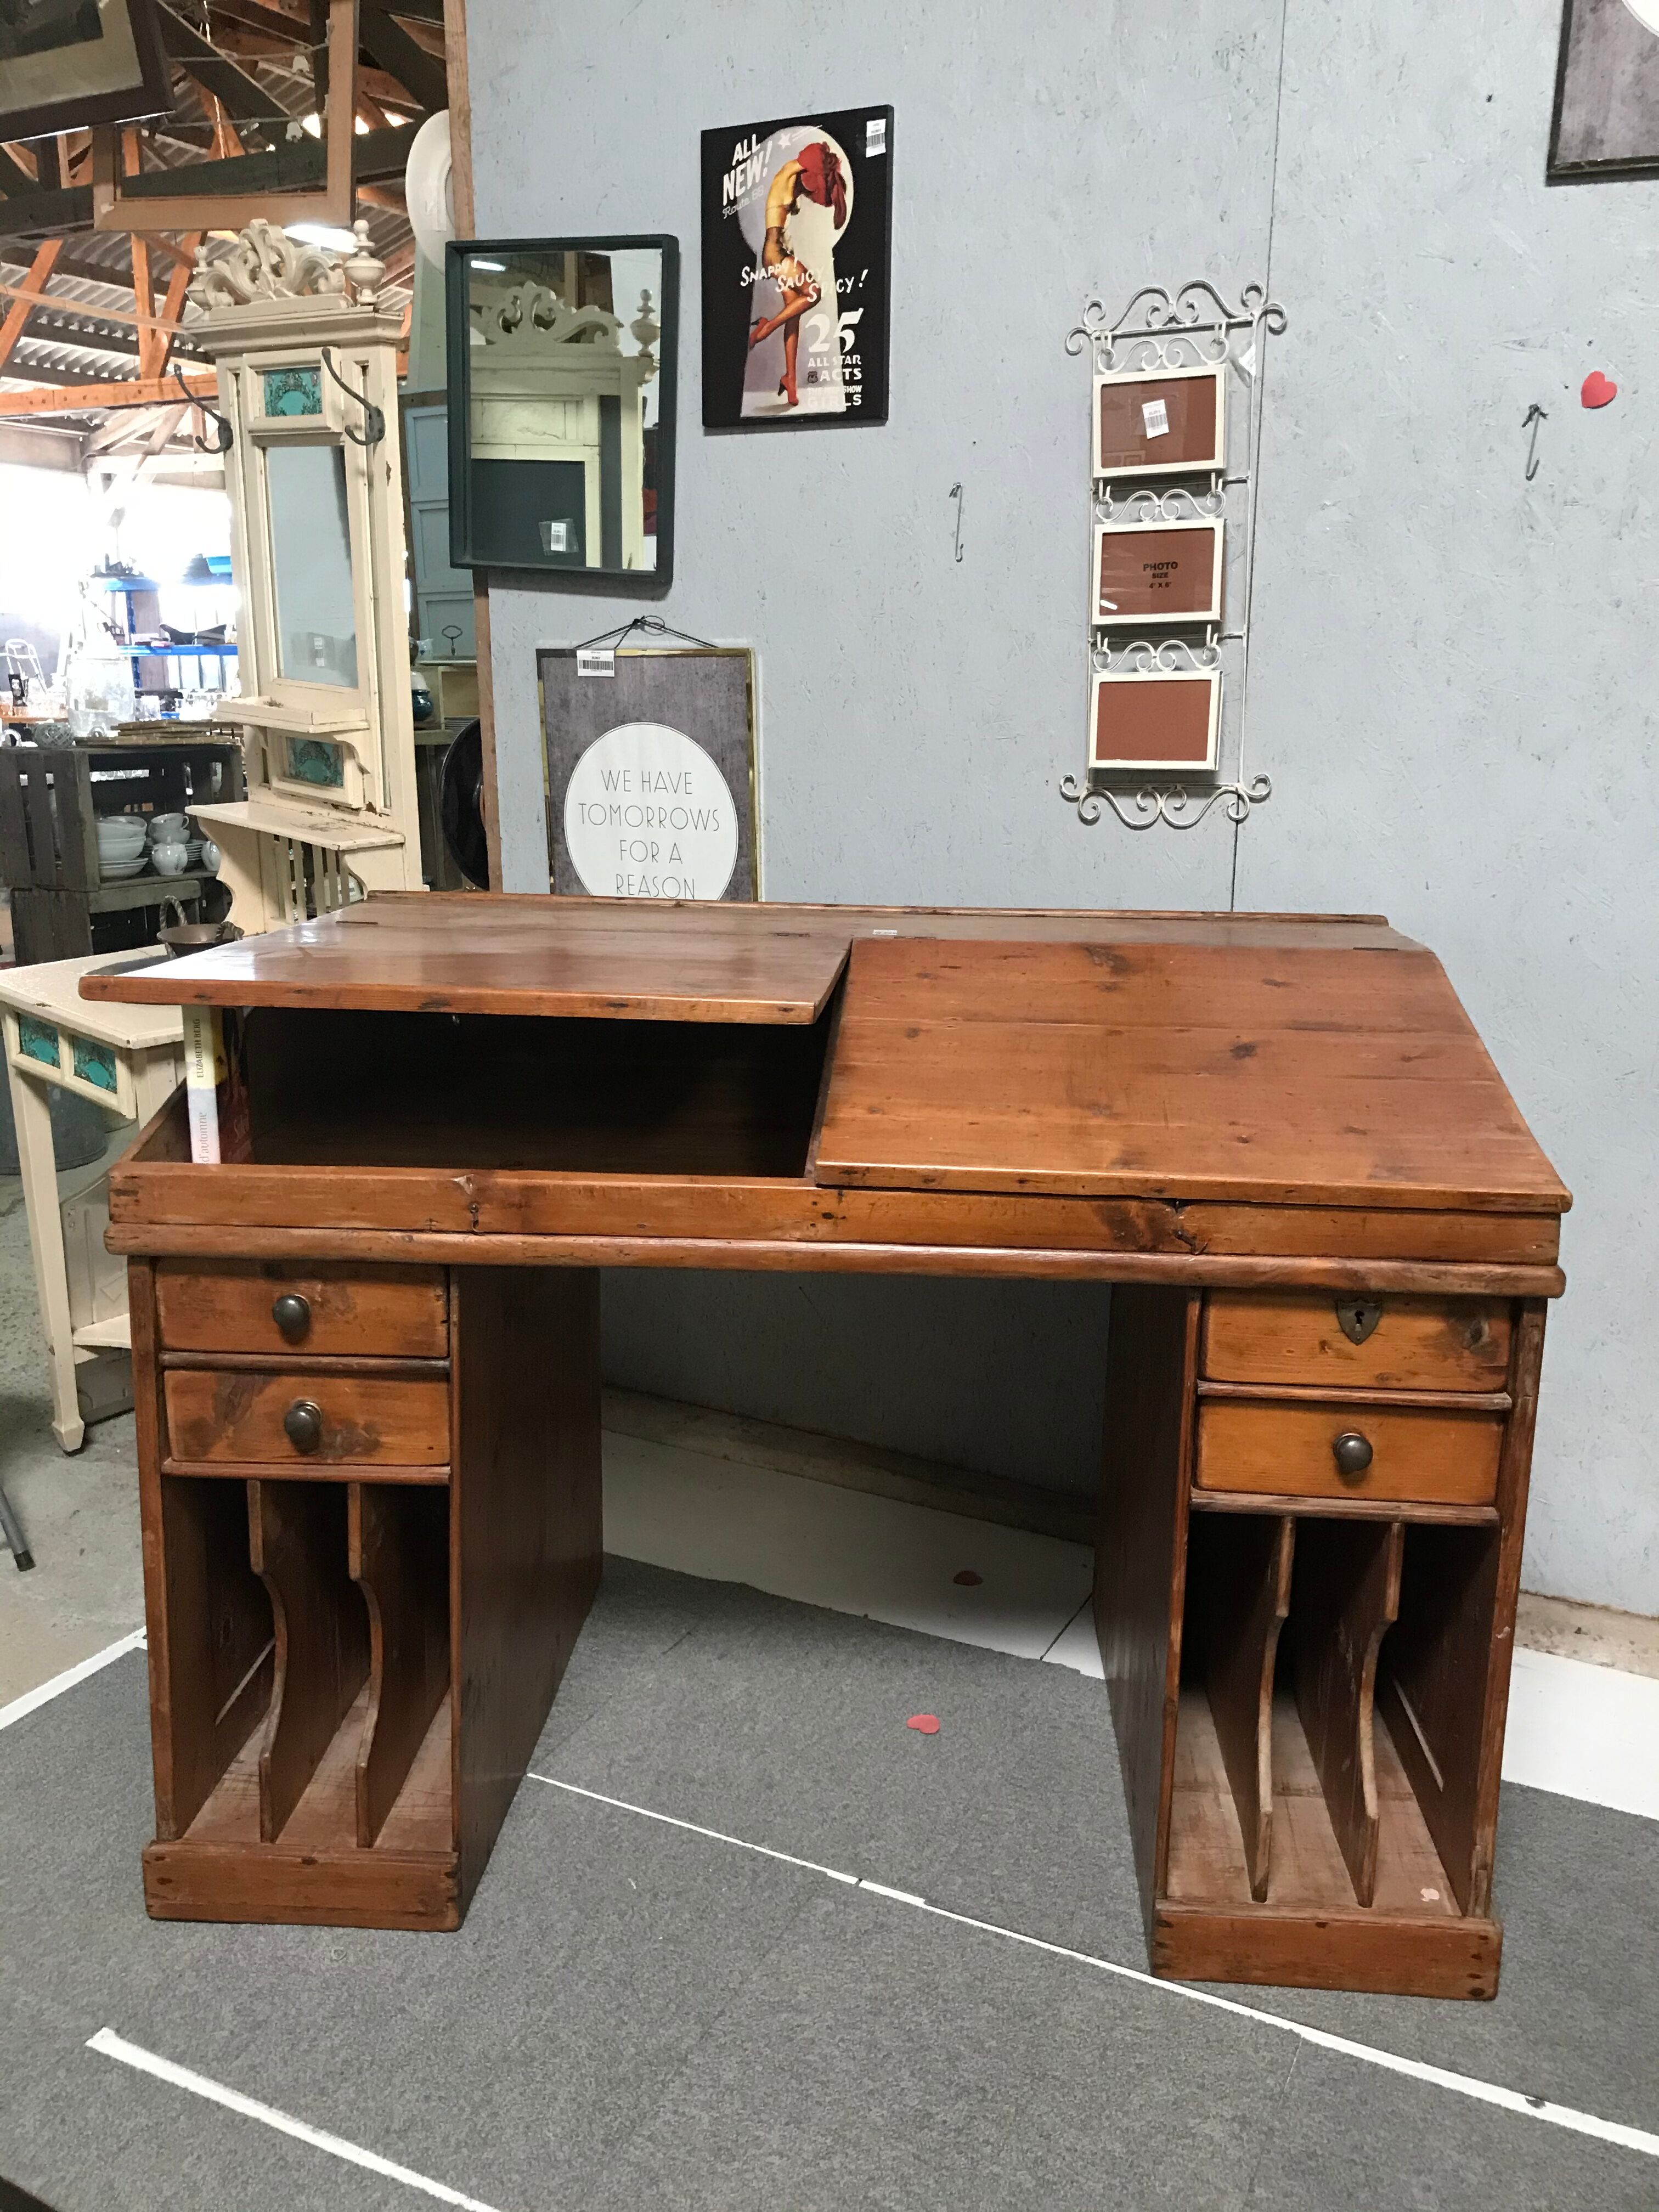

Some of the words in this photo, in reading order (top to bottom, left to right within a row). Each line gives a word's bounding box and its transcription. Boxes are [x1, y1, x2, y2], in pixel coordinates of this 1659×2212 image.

[732, 133, 760, 166] ALL
[723, 140, 772, 206] NEW!
[722, 198, 751, 219] Route
[805, 307, 864, 353] 25
[808, 357, 830, 368] ALL
[832, 354, 862, 366] STAR
[820, 368, 862, 382] ACTS
[808, 394, 862, 408] GIRLS
[843, 385, 862, 393] SHOW
[1143, 561, 1178, 572] PHOTO
[601, 770, 631, 792] WE
[641, 771, 692, 794] HAVE
[578, 803, 720, 831] TOMORROWS
[620, 839, 659, 863] FOR
[669, 842, 683, 864] A
[616, 873, 695, 899] REASON
[193, 1018, 201, 1038] BERG
[194, 1040, 204, 1078] ELIZABETH
[199, 1112, 210, 1162] d'automne
